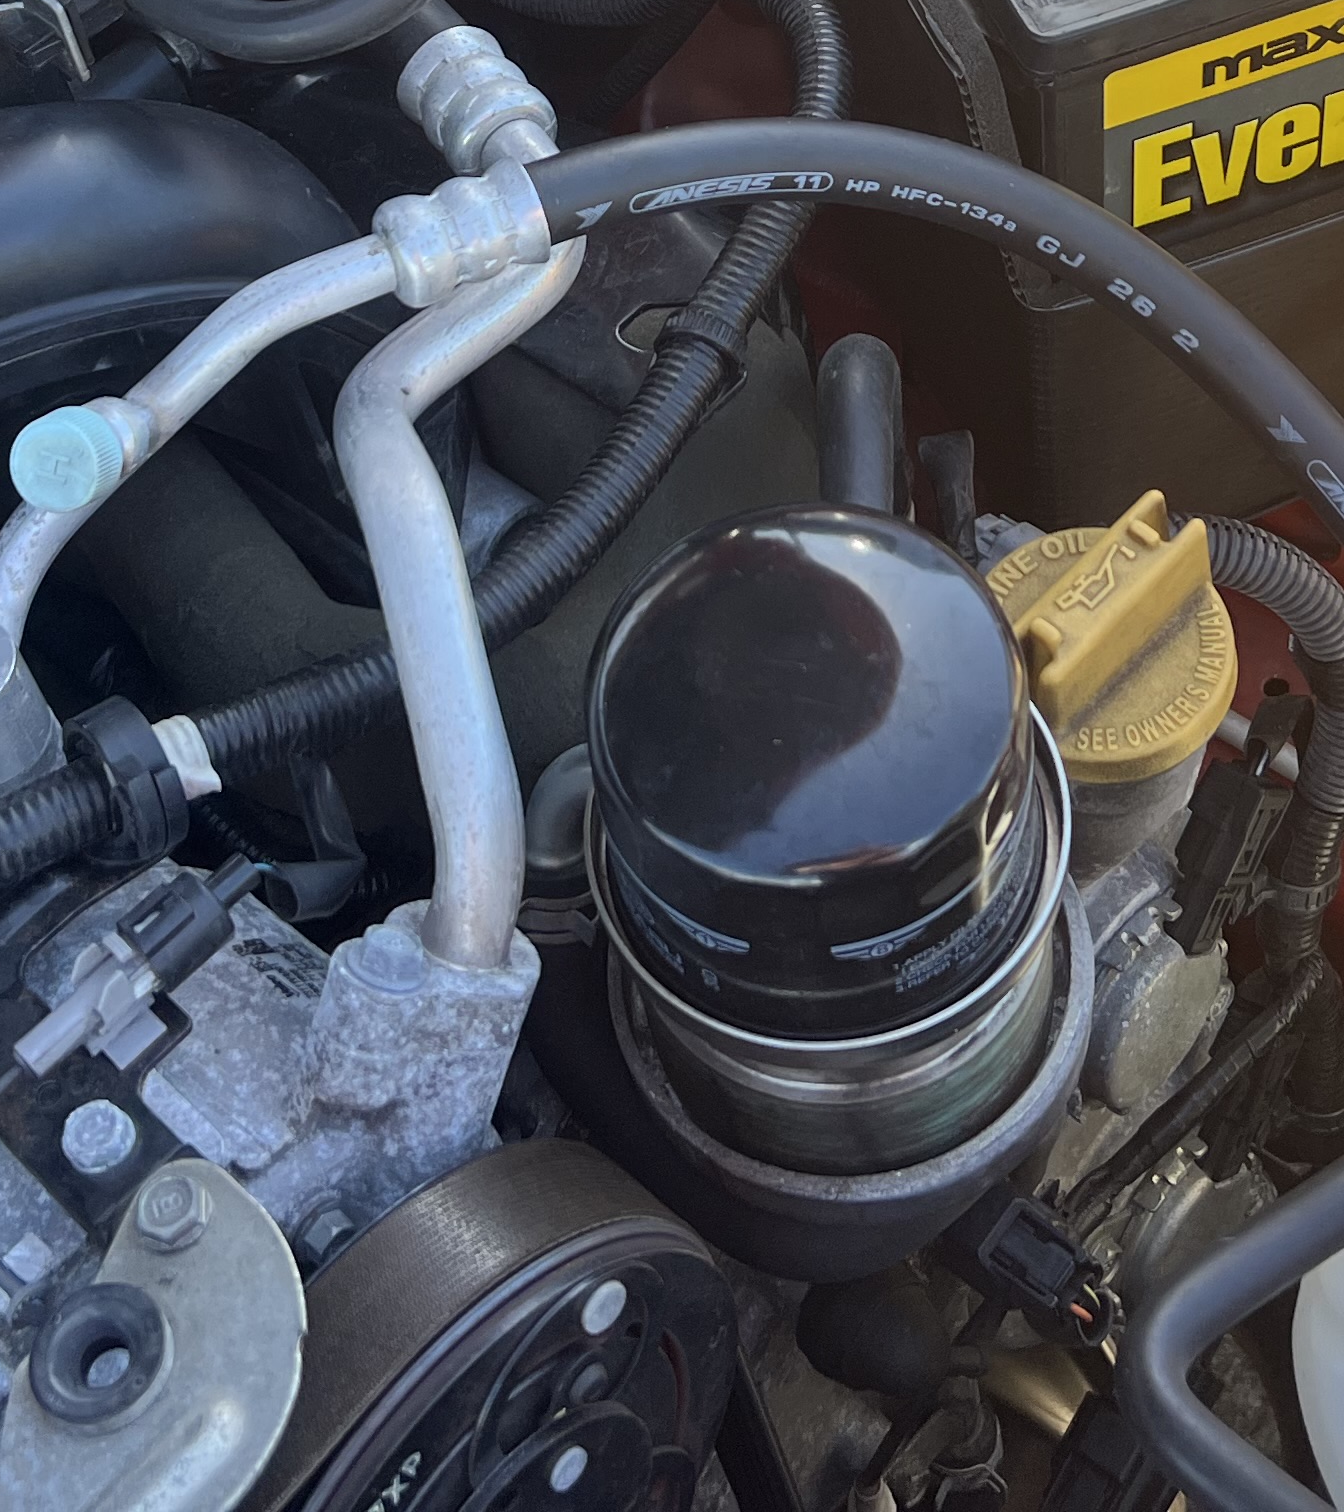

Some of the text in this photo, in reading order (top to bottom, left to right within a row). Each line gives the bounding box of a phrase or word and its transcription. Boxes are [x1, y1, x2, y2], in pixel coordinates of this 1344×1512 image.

[648, 175, 1201, 355] ANESIS 11 HP HFC-134a GJ 26 2
[987, 531, 1094, 608] INE OIL
[1077, 602, 1228, 752] SEE OWNER'S MANUAL
